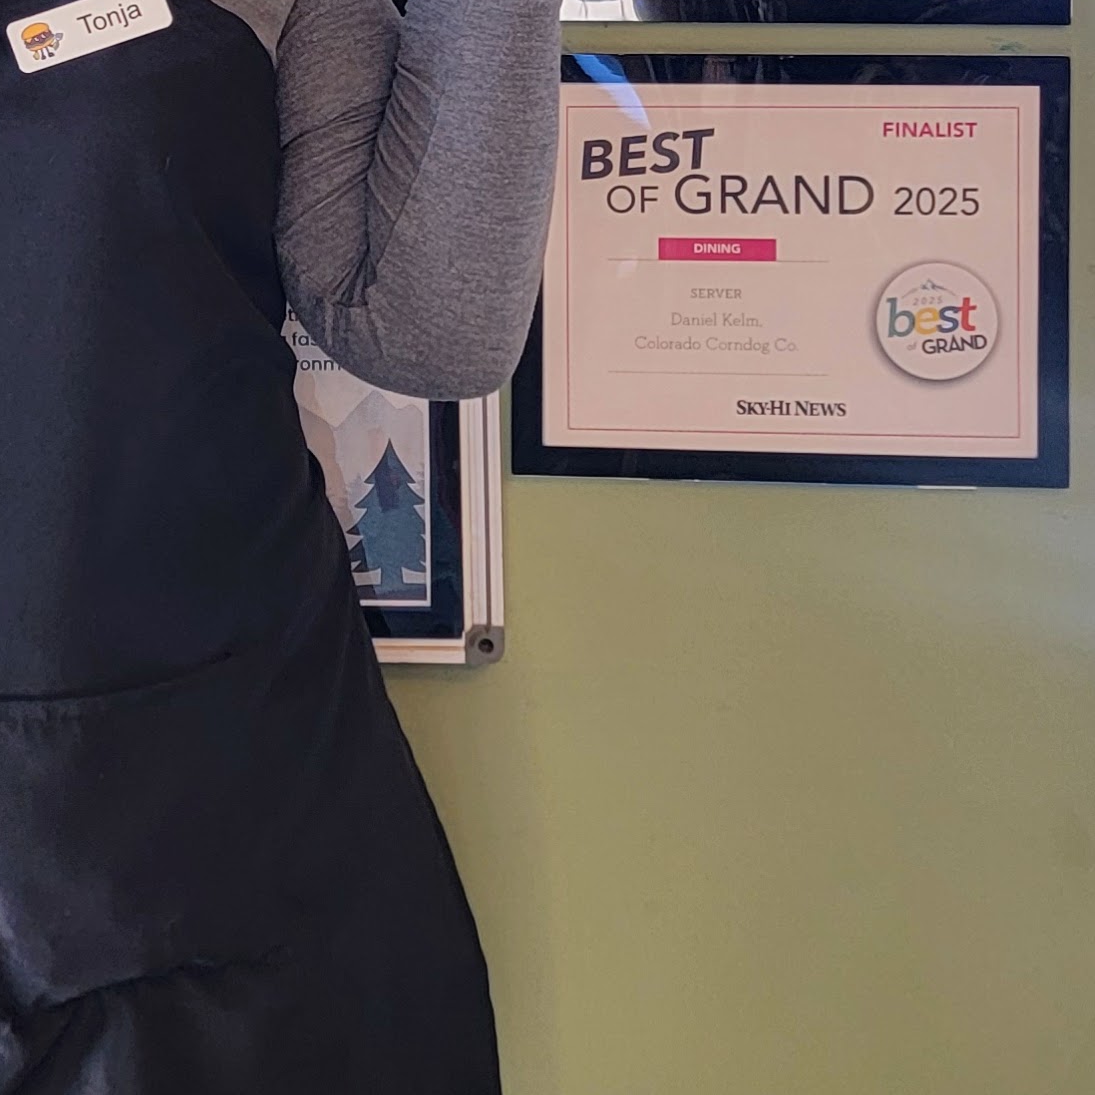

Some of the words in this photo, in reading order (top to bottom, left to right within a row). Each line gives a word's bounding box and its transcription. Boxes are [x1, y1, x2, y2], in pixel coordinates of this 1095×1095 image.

[76, 1, 143, 35] Tonja
[883, 122, 977, 138] FINALIST
[581, 128, 715, 180] BEST
[606, 185, 658, 214] OF
[674, 175, 874, 215] GRAND
[894, 187, 980, 216] 2025
[693, 242, 741, 255] DINING
[690, 288, 742, 299] SERVER
[671, 312, 717, 327] Daniel
[886, 297, 976, 338] best
[634, 336, 701, 351] Colorado
[706, 337, 770, 354] Corndog
[775, 338, 798, 352] Co.
[921, 334, 987, 355] GRAND
[794, 401, 846, 417] NEWS
